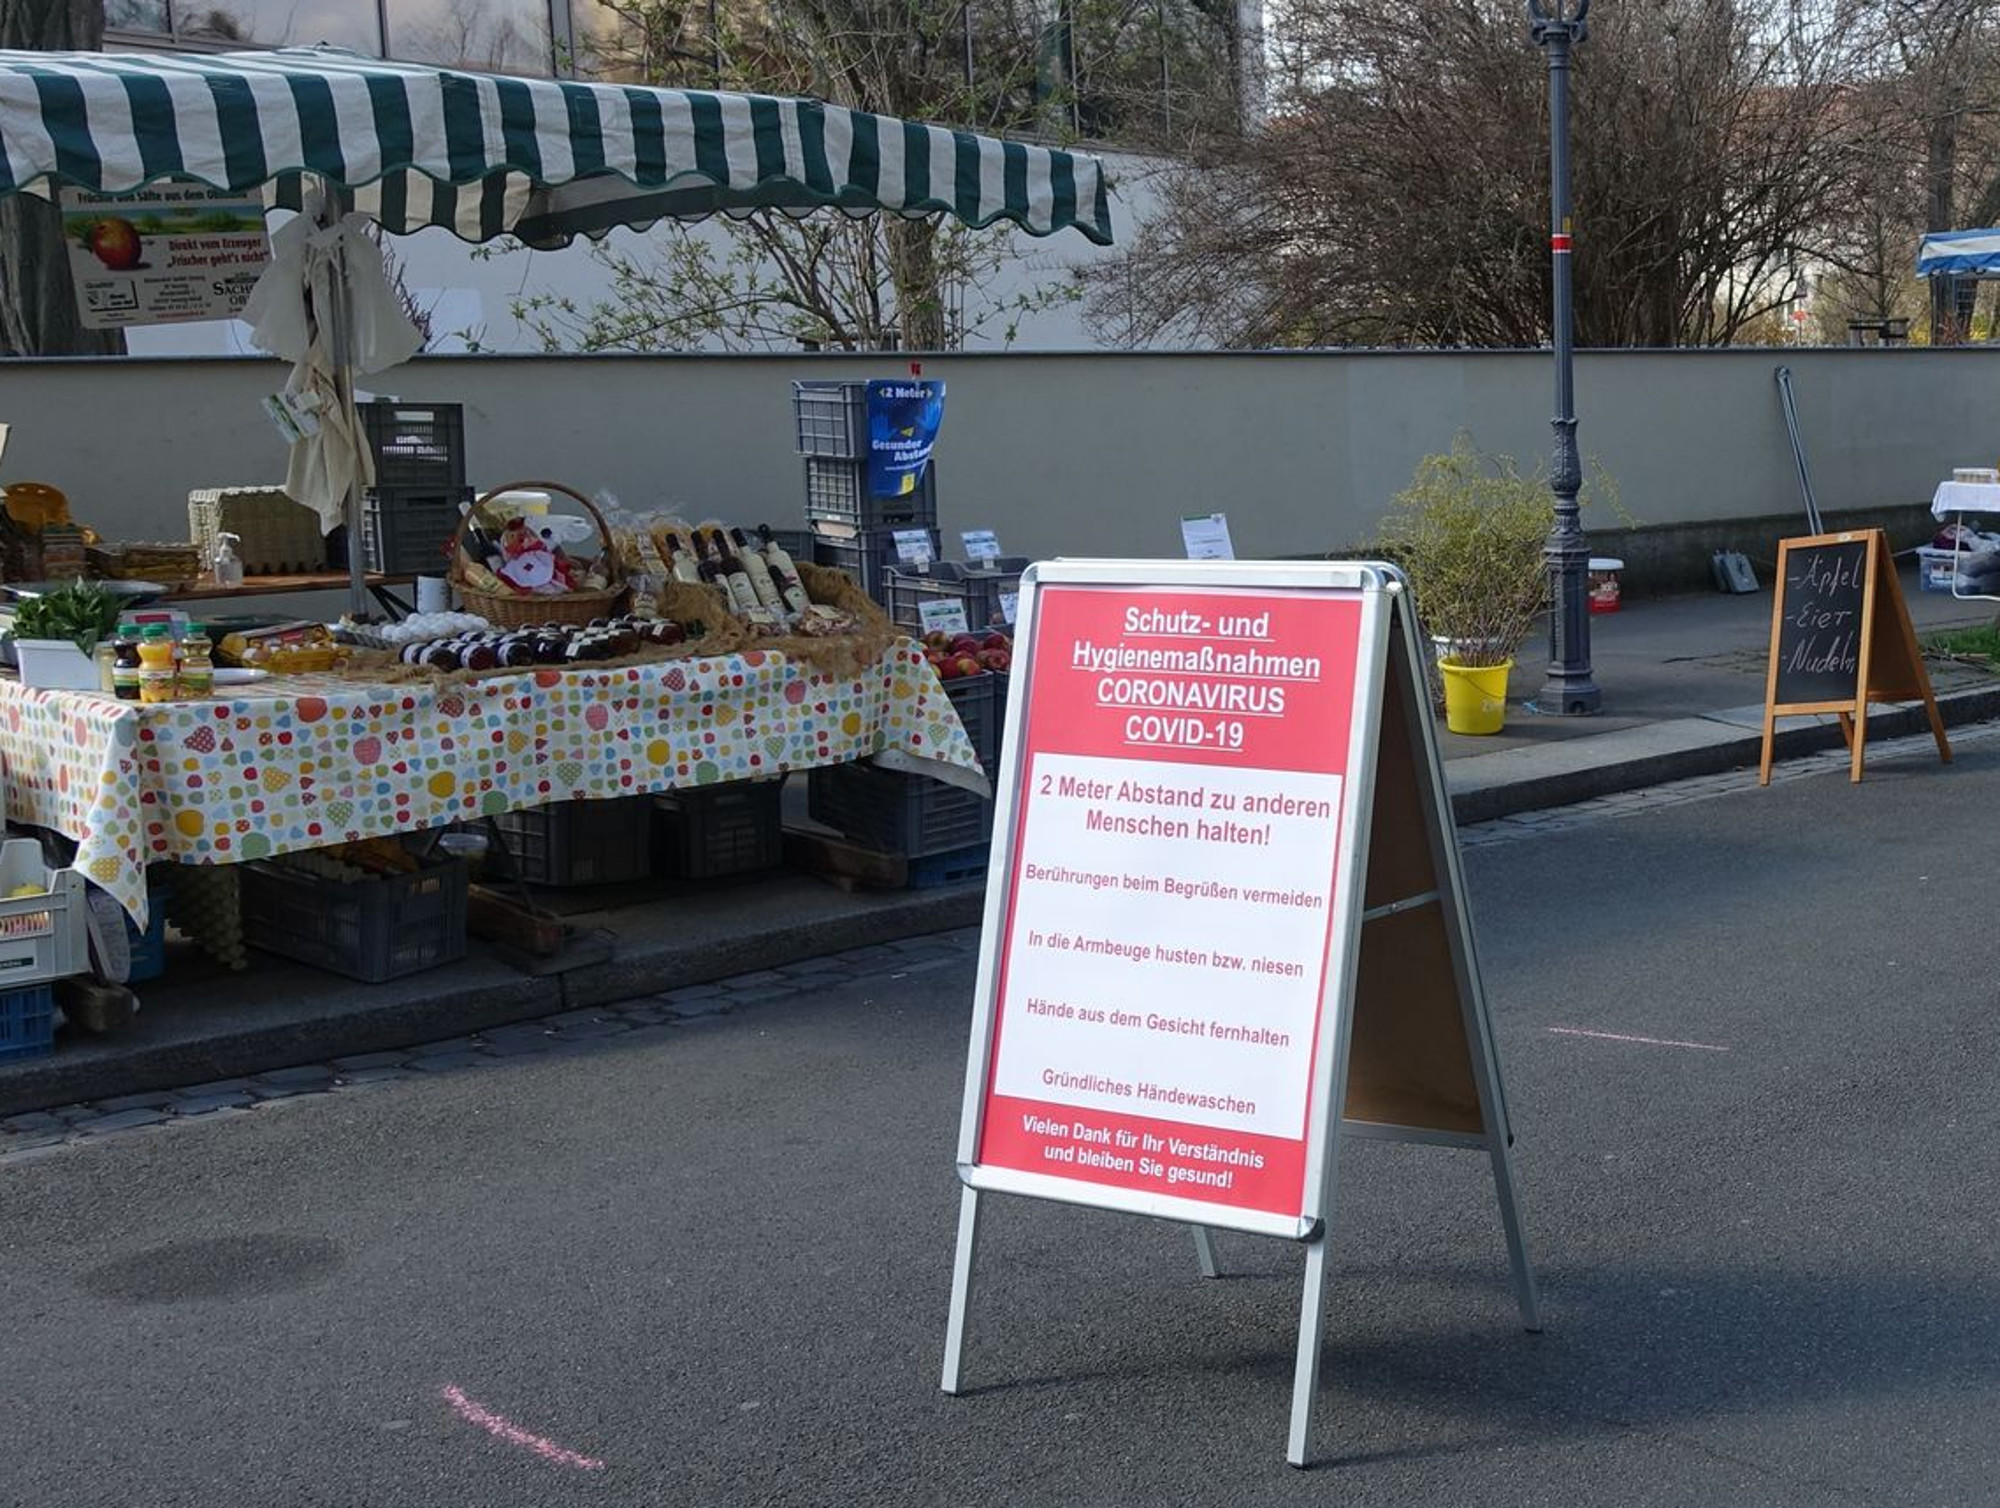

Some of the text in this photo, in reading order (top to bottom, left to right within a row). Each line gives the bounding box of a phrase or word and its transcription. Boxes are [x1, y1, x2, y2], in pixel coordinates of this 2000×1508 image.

[885, 387, 925, 399] 2 Meter
[872, 439, 923, 451] Gesunder
[1124, 606, 1269, 637] Schutz- und
[1073, 641, 1321, 678] Hygienemaßnahmen
[1097, 678, 1285, 712] CORONAVIRUS
[1125, 716, 1244, 746] COVID-19
[1040, 774, 1330, 818] 2 Meter Abstand zu anderen
[1086, 810, 1270, 846] Menschen halten!
[1026, 864, 1322, 908] Berührungen beim Begrüßen vermeiden
[1028, 930, 1303, 976] In die Armbeuge husten bzw. niesen
[1027, 998, 1289, 1047] Hände aus dem Gesicht fernhalten
[1042, 1068, 1256, 1115] Gründliches Händewaschen
[1023, 1114, 1264, 1169] Vielen Dank für Ihr Verständnis
[1044, 1146, 1233, 1189] und bleiben Sie gesund!
